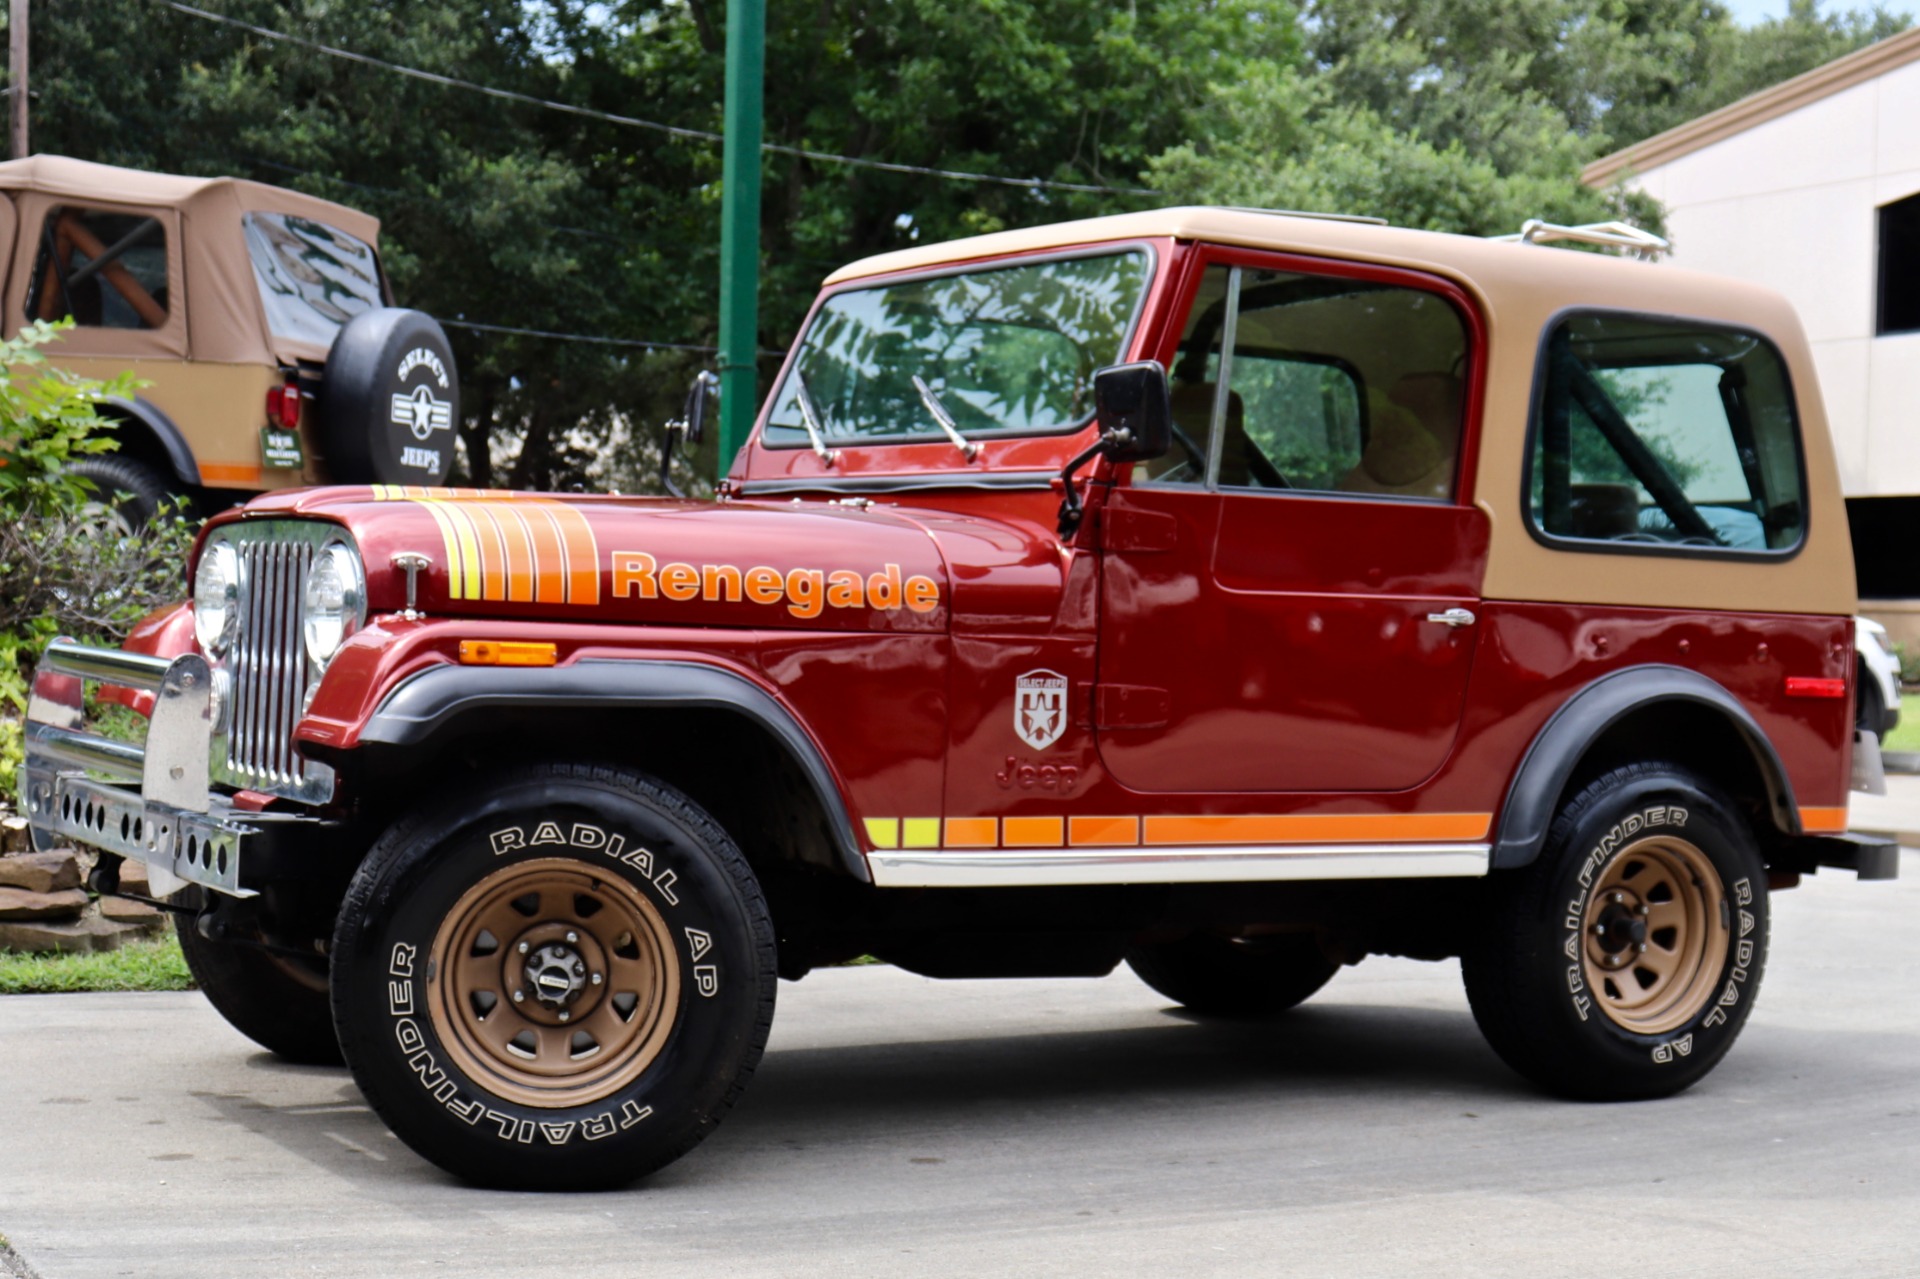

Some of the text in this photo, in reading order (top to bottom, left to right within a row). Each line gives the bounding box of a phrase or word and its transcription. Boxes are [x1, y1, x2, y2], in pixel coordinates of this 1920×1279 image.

[398, 347, 450, 389] SELECT
[400, 446, 440, 468] JEEPS
[611, 551, 940, 619] Renegade
[490, 821, 718, 998] RADIAL AP
[1563, 805, 1689, 1022] TRAILFINDER
[1652, 877, 1755, 1064] RADIAL AP
[388, 942, 654, 1145] TRAILFINDER
